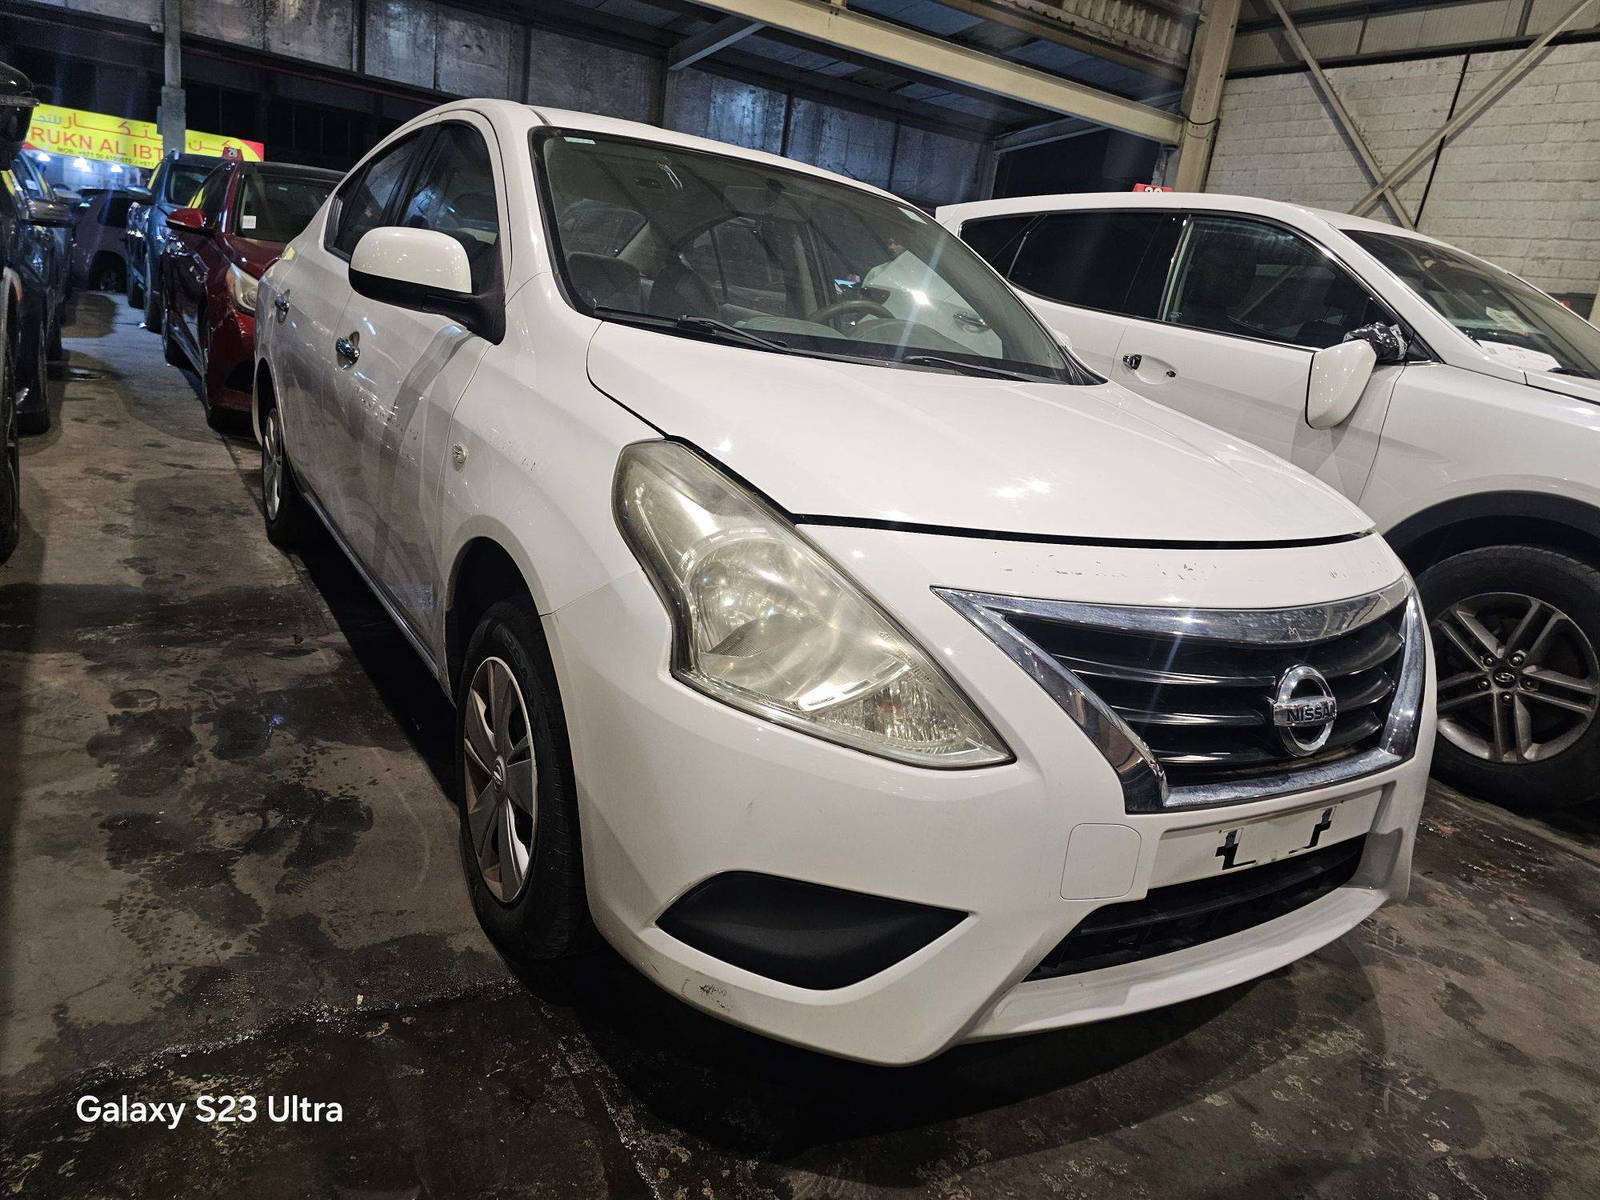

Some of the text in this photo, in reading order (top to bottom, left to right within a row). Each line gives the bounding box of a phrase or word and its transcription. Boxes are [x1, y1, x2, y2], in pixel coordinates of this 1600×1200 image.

[31, 126, 92, 150] RUKN
[99, 139, 126, 156] AL
[1286, 700, 1336, 722] NISSAN
